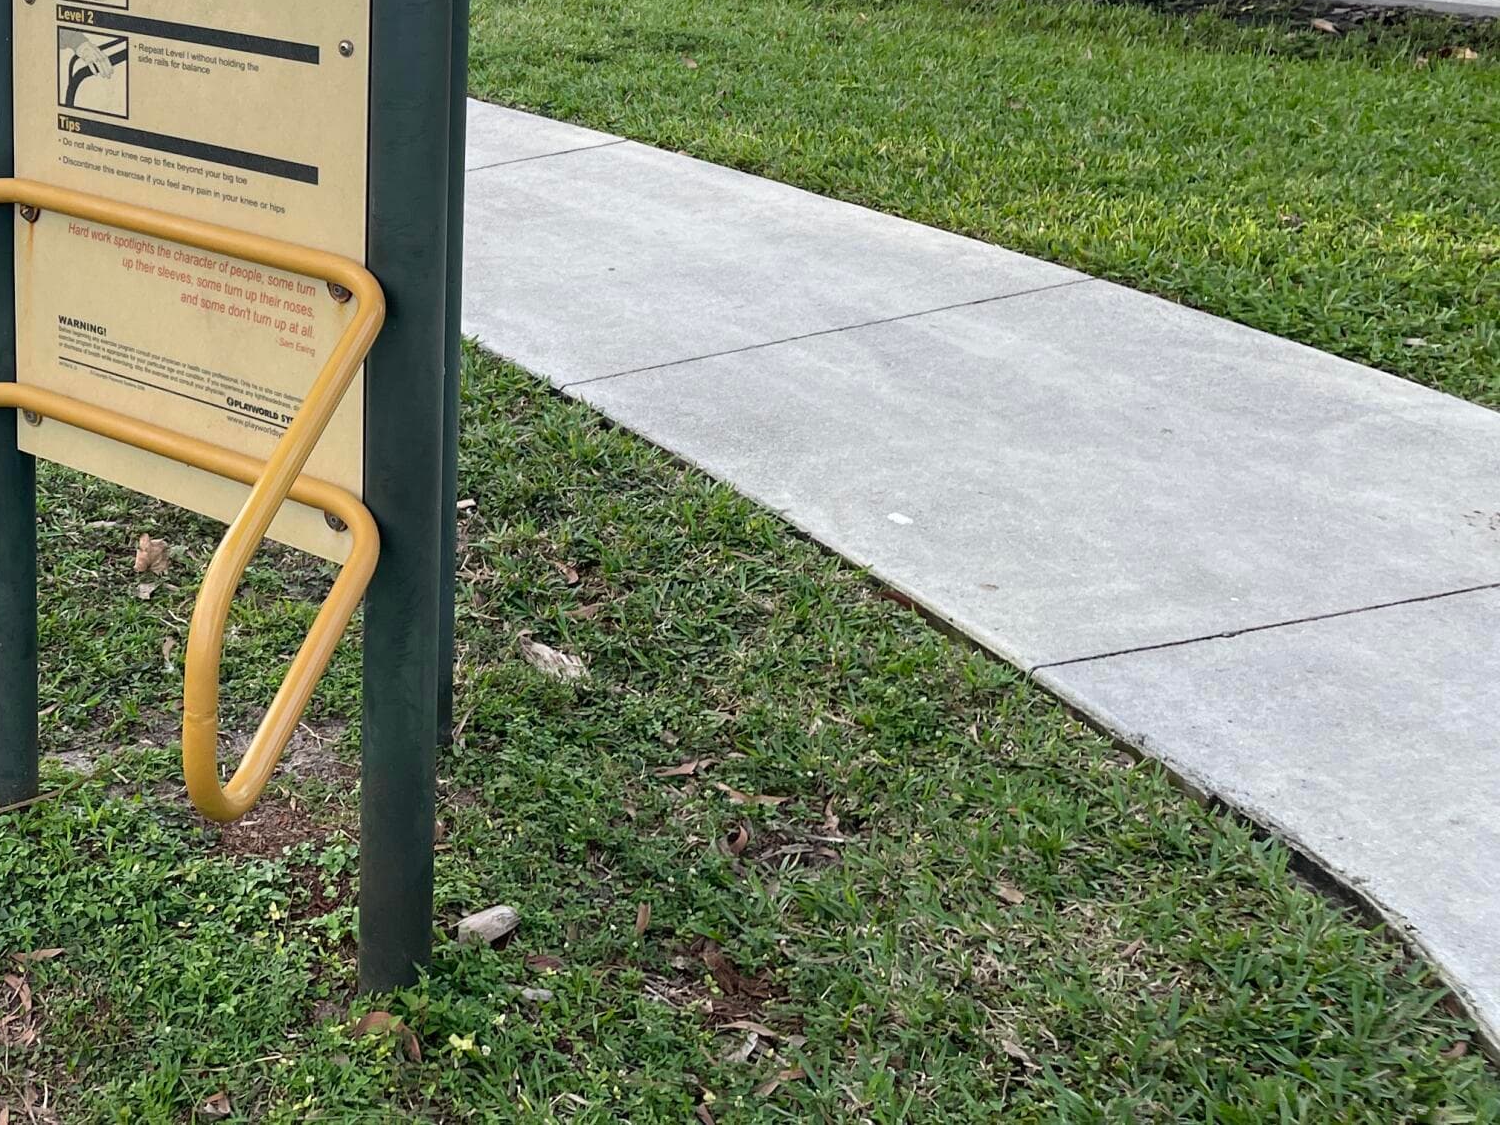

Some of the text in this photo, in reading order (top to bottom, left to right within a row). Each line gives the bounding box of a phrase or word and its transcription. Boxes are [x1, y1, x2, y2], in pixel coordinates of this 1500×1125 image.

[59, 6, 94, 24] Level 2
[139, 43, 163, 54] Repeat
[166, 48, 185, 58] Level
[191, 53, 217, 64] without
[219, 58, 245, 71] holding
[247, 63, 259, 72] the
[139, 55, 210, 74] side rails for balance
[60, 116, 80, 132] Tips
[63, 138, 247, 185] Do not allow your knee cap to flex beyond your big toe
[63, 156, 101, 171] Discontinue
[103, 165, 115, 175] this
[116, 170, 145, 181] exercise
[153, 178, 165, 186] you
[167, 179, 180, 189] feel
[181, 184, 194, 194] any
[197, 187, 212, 197] pain
[214, 191, 220, 199] in
[222, 193, 238, 203] your
[240, 195, 258, 208] knee
[260, 201, 268, 210] or
[270, 203, 285, 214] hips
[69, 223, 89, 238] Hard
[91, 231, 111, 244] work
[114, 235, 155, 255] spotlights
[157, 245, 171, 258] the
[173, 250, 216, 270] character
[219, 261, 228, 273] of
[268, 275, 294, 291] some
[296, 281, 316, 297] turn
[123, 258, 315, 319] up their sleeves, some turn up their noses,
[59, 315, 107, 336] WARNING!
[181, 293, 315, 339] and some don't turn up at all.
[235, 399, 279, 420] PLAYWORLD
